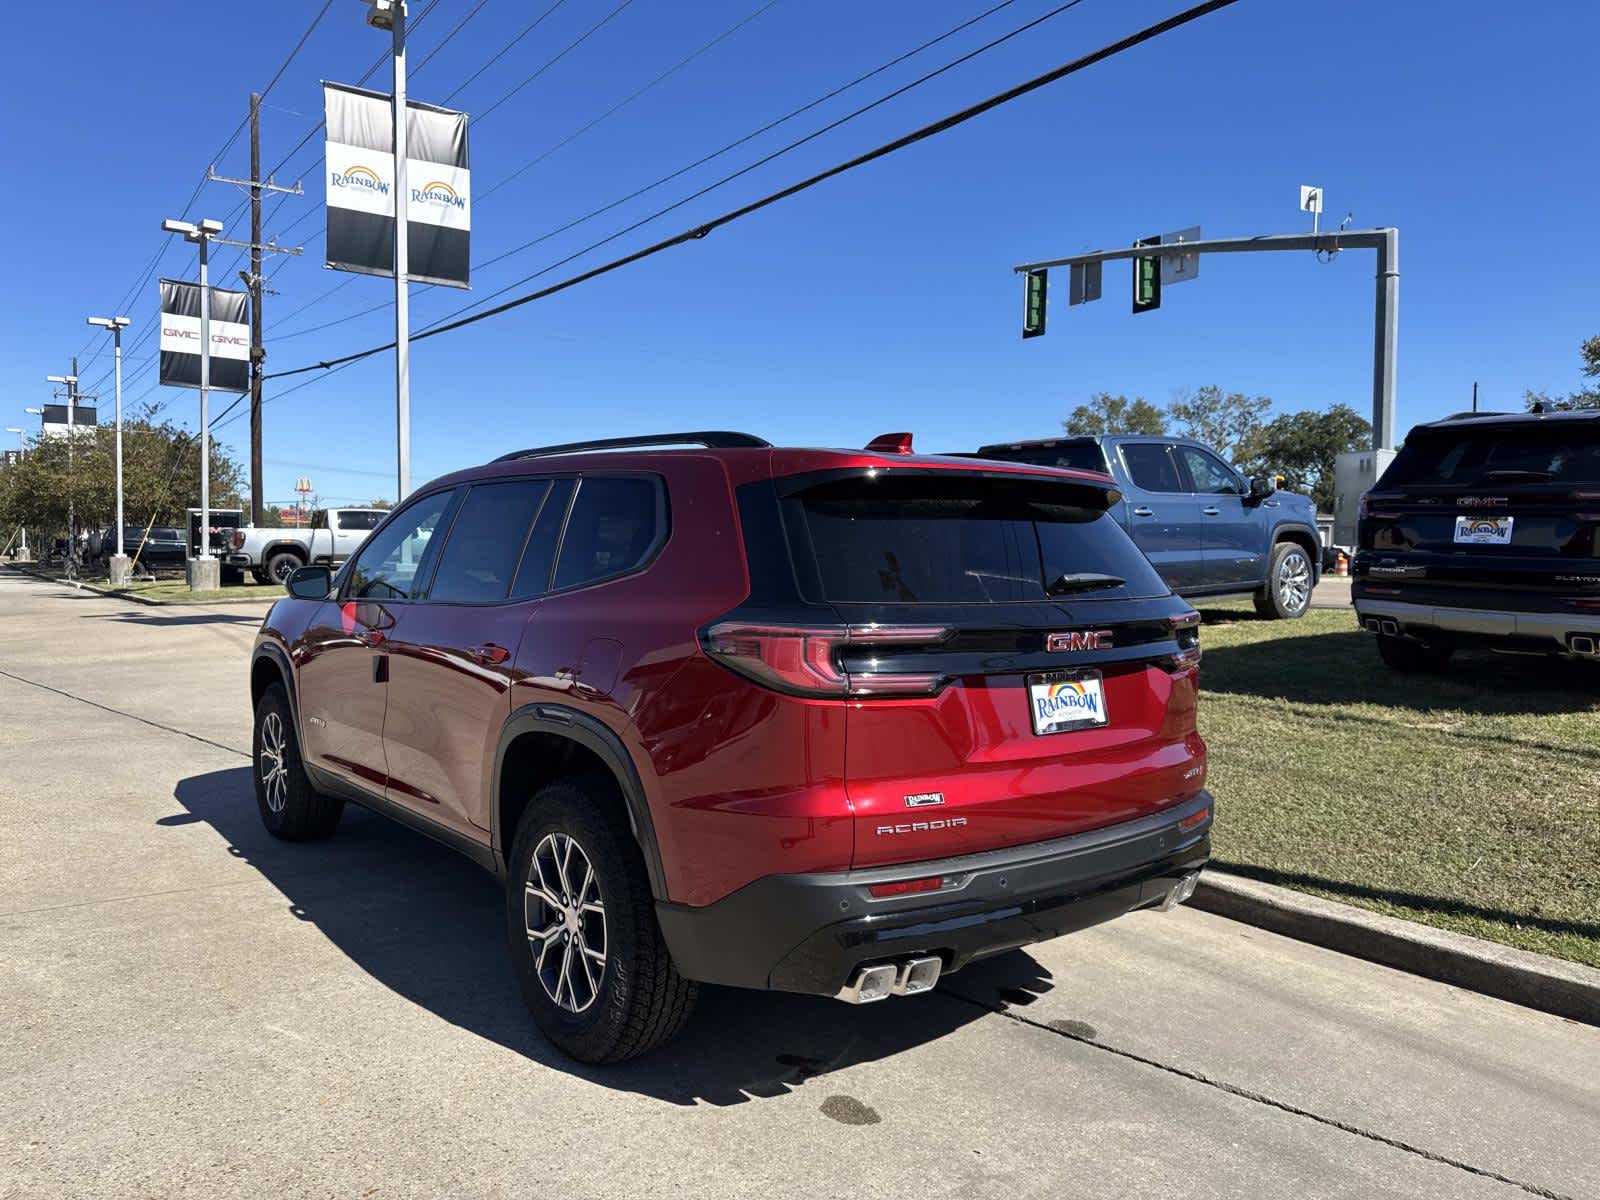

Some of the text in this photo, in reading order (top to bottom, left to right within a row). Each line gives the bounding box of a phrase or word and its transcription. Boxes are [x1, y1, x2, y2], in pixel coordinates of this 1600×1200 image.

[331, 172, 390, 196] RAINBOW
[411, 189, 466, 210] RAINBOW
[163, 328, 201, 340] GMC
[211, 335, 249, 346] GMC
[1460, 526, 1508, 537] RAINBOW
[1047, 630, 1113, 652] GMC
[1037, 693, 1097, 719] RAINBOW
[877, 818, 967, 835] ACADIA
